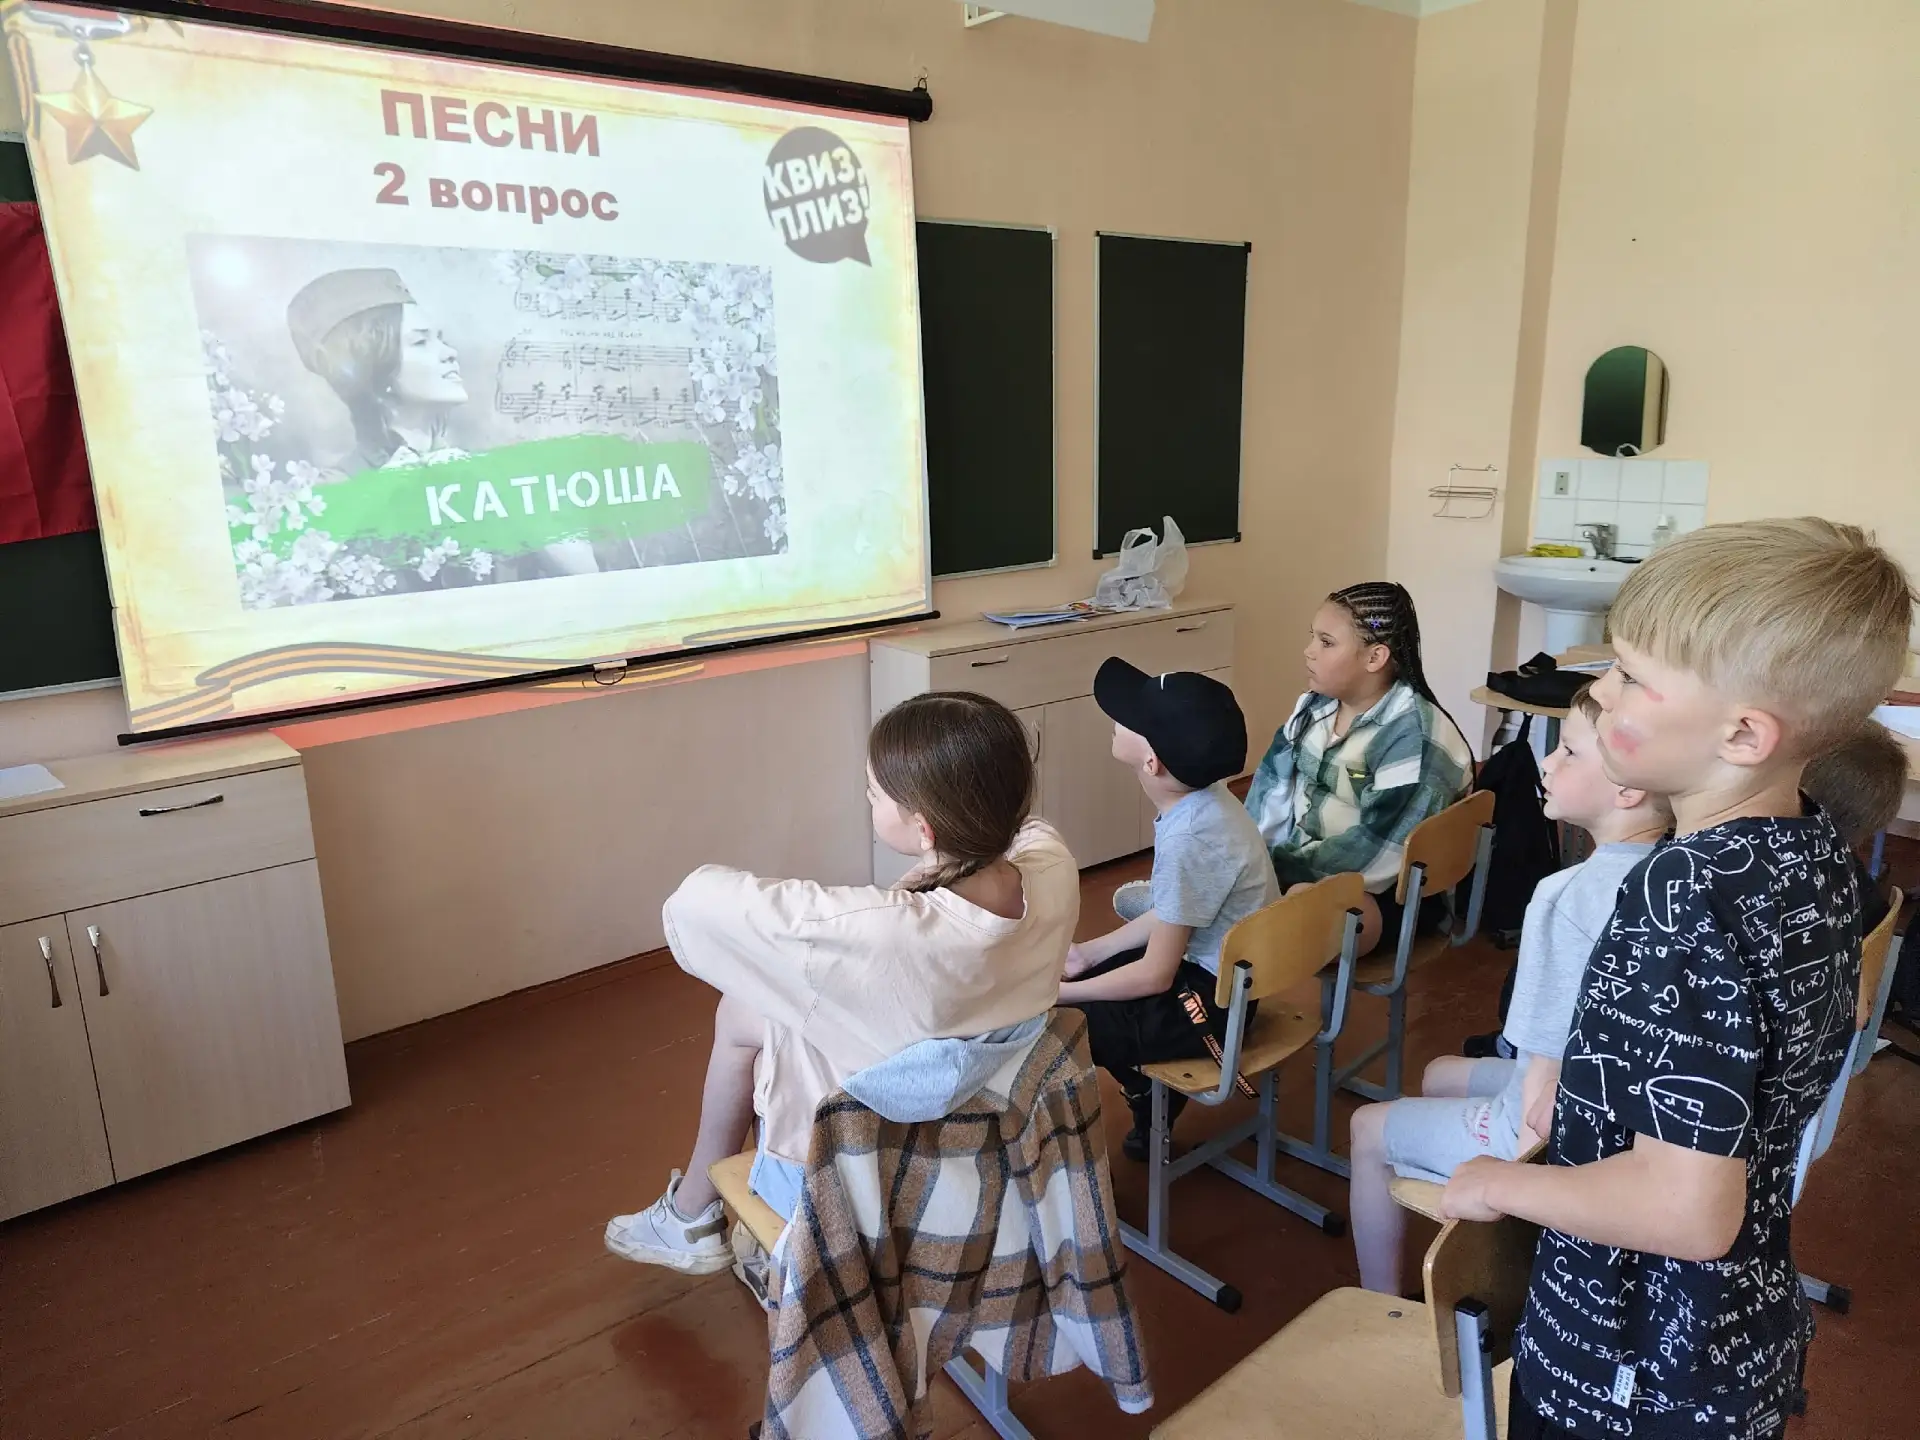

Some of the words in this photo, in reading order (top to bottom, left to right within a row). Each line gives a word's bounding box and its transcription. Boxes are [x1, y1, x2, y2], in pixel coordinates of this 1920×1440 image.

[380, 89, 601, 157] ПЕСНИ
[372, 162, 409, 206] 2
[428, 177, 620, 225] вопрос
[770, 186, 870, 241] ПЛИЗ!
[425, 463, 682, 526] КАТЮША
